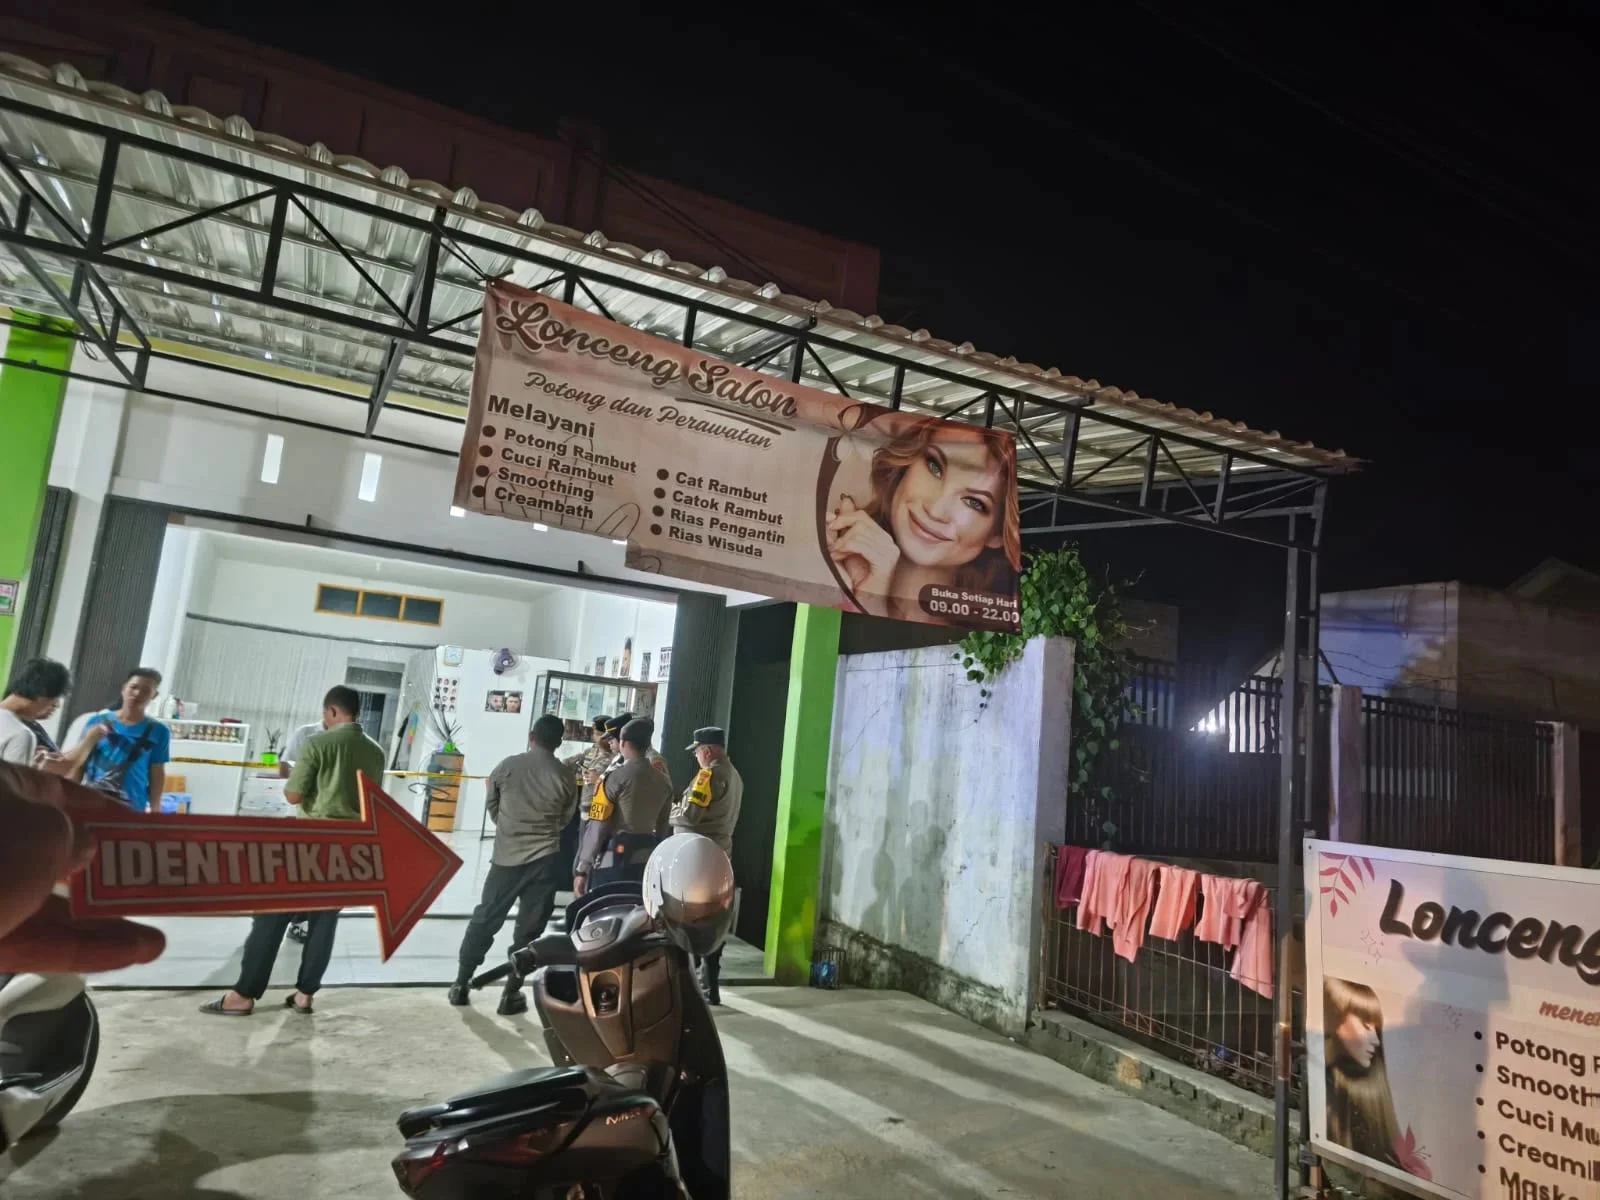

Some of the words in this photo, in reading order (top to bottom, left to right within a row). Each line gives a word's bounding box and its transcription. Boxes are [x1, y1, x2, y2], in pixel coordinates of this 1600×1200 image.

[497, 300, 680, 387] Lonceng
[688, 359, 798, 418] Salon
[487, 394, 596, 439] Melayani
[524, 371, 607, 412] Potong
[609, 396, 654, 419] dan
[656, 405, 773, 449] Perawatan
[500, 447, 543, 469] Cuci
[547, 457, 615, 487] Rambut
[504, 427, 568, 457] Potong
[572, 444, 638, 474] Rambut
[494, 486, 594, 520] Creambath
[497, 466, 595, 503] Smoothing
[675, 471, 704, 489] Cat
[707, 478, 769, 504] Rambut
[669, 507, 705, 528] Rias
[708, 516, 786, 545] Pengantin
[672, 489, 720, 512] Catok
[723, 500, 784, 526] Rambut
[668, 525, 704, 544] Rias
[707, 534, 763, 558] Wisuda
[929, 599, 970, 616] 09.00
[981, 606, 1021, 624] 22.00
[931, 587, 959, 600] Buka
[960, 591, 994, 606] Setiap
[995, 597, 1018, 609] Hari
[101, 840, 385, 888] IDENTIFIKASI
[1379, 878, 1600, 986] Lonceng
[1495, 1030, 1586, 1077] Potong
[1497, 1099, 1555, 1134] Cuci
